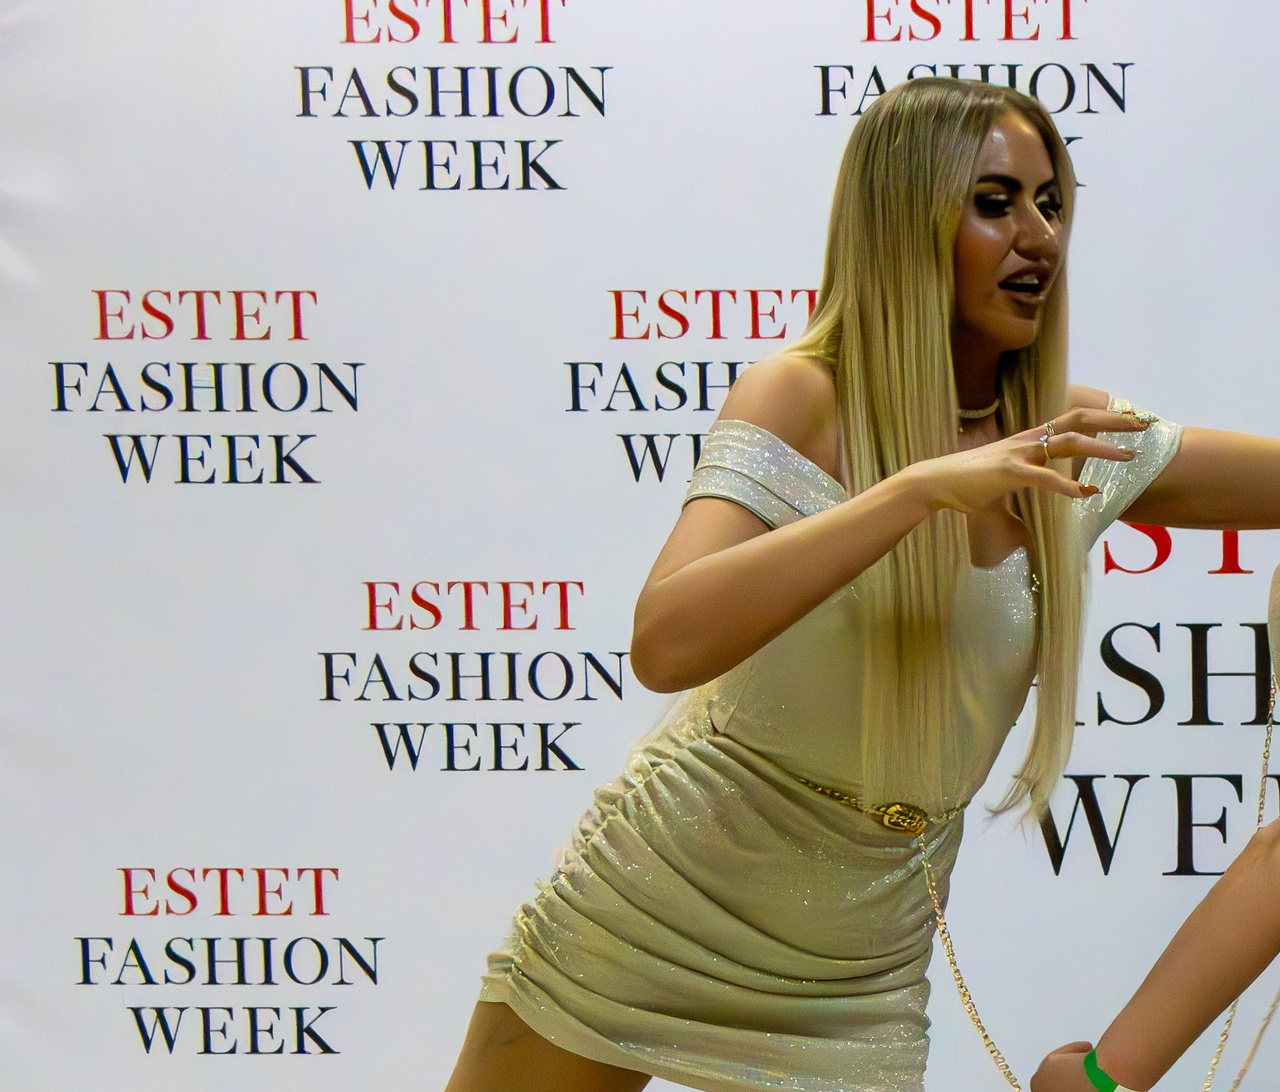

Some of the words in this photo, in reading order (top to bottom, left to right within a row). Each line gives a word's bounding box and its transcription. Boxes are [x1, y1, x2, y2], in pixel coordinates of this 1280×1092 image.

[340, 0, 566, 44] ESTET
[294, 66, 614, 117] FASHION
[347, 140, 568, 191] WEEK
[91, 290, 317, 340] ESTET
[48, 362, 365, 412] FASHION
[563, 361, 758, 412] FASH
[103, 434, 321, 484] WEEK
[362, 581, 584, 630] ESTET
[318, 652, 629, 701] FASHION
[370, 722, 585, 772] WEEK
[117, 868, 339, 916] ESTET
[74, 937, 386, 985] FASHION
[127, 1006, 341, 1055] WEEK
